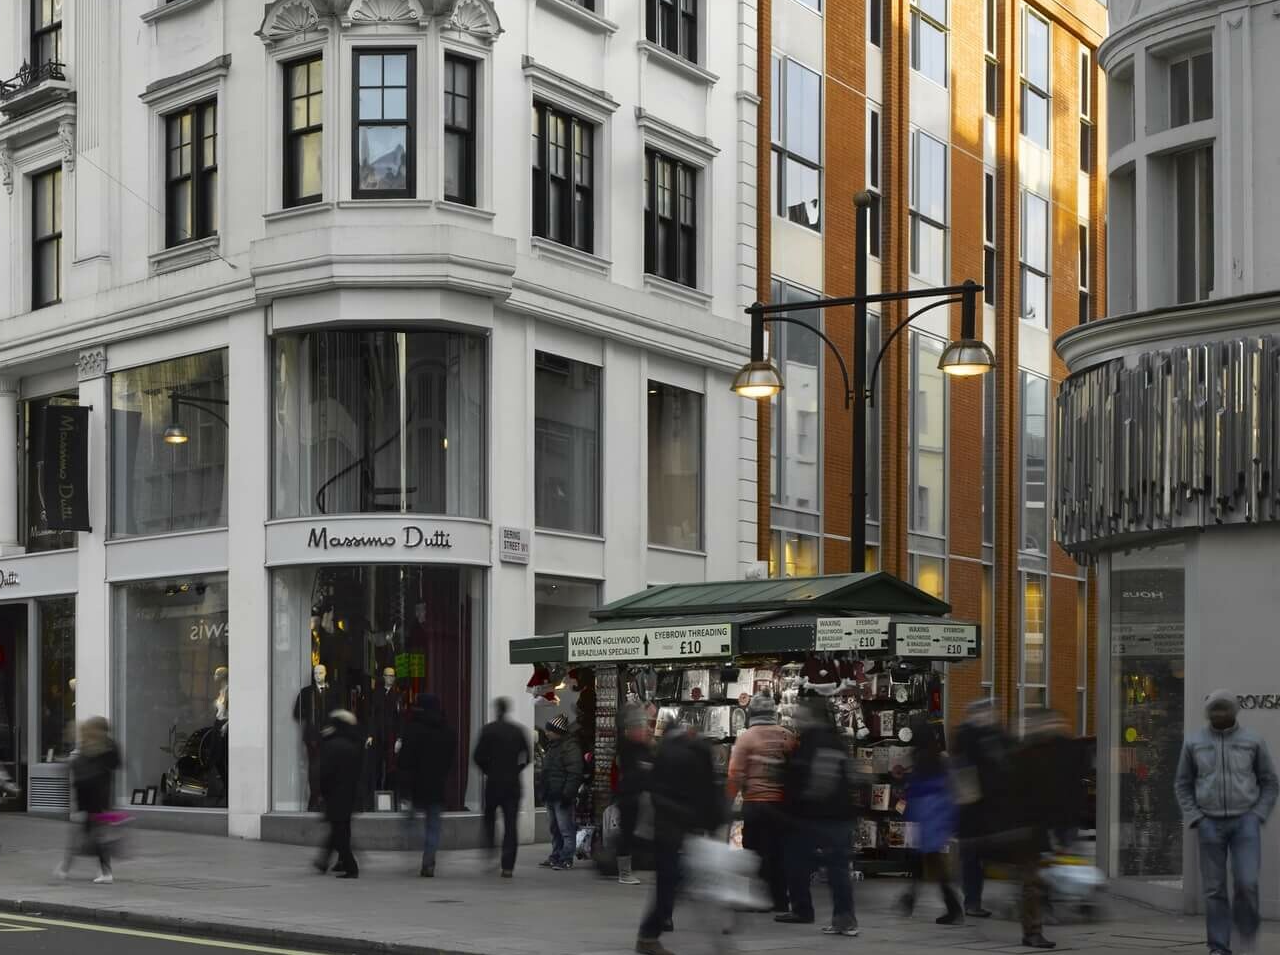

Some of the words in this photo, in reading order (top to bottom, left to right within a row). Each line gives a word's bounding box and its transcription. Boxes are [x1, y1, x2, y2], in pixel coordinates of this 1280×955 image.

[59, 414, 75, 480] Massimo
[59, 485, 74, 521] Dutti
[307, 527, 397, 550] Massimo
[402, 526, 452, 549] Dutti
[503, 529, 521, 540] DERING
[503, 540, 520, 552] STREET
[654, 630, 687, 640] EYEBROW
[688, 627, 728, 638] THREADING
[571, 636, 602, 646] WAXING
[603, 636, 640, 645] HOLLYWOOD
[859, 637, 875, 647] £10
[577, 649, 607, 657] BRAZILIAN
[608, 647, 640, 656] SPECIALIST
[680, 640, 702, 655] £10
[947, 645, 962, 654] £10
